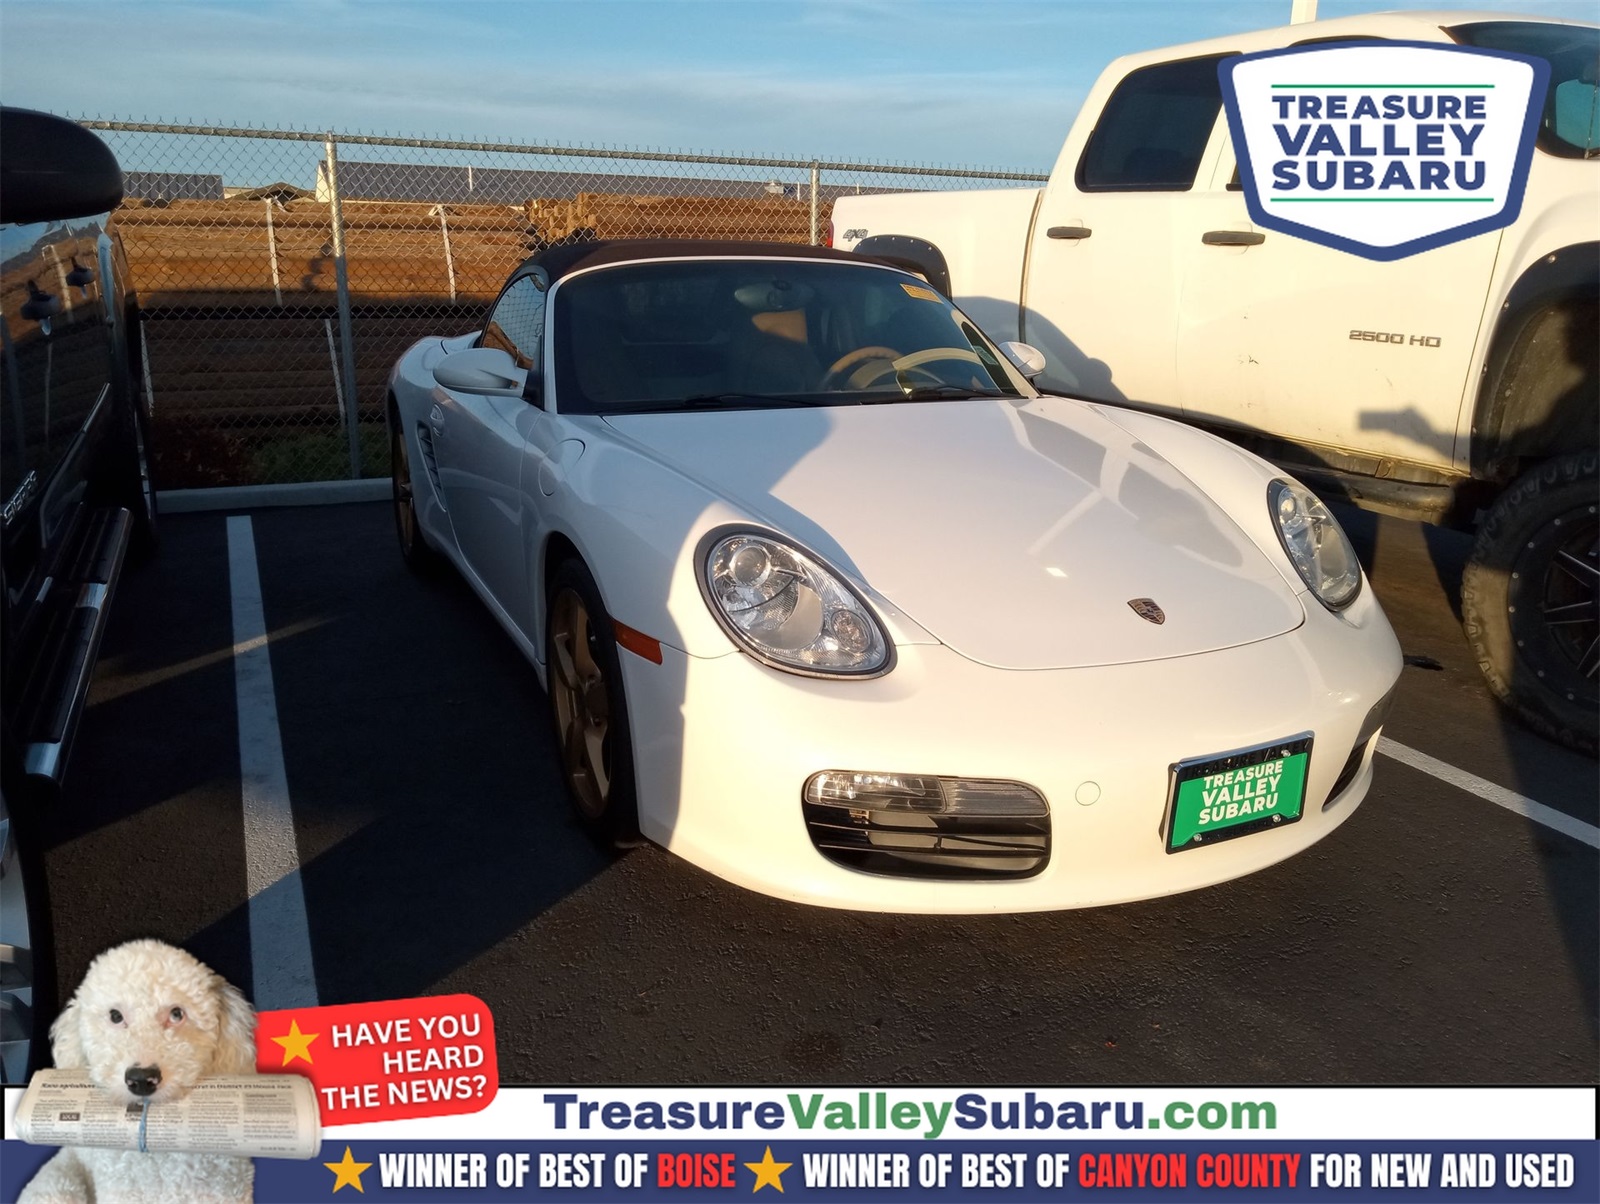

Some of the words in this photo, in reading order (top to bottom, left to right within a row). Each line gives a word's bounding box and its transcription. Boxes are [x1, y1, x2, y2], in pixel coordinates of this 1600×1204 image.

[1349, 330, 1405, 344] 2500
[1203, 760, 1284, 789] TREASURE
[1201, 774, 1282, 807] VALLEY
[1198, 792, 1279, 825] SUBARU
